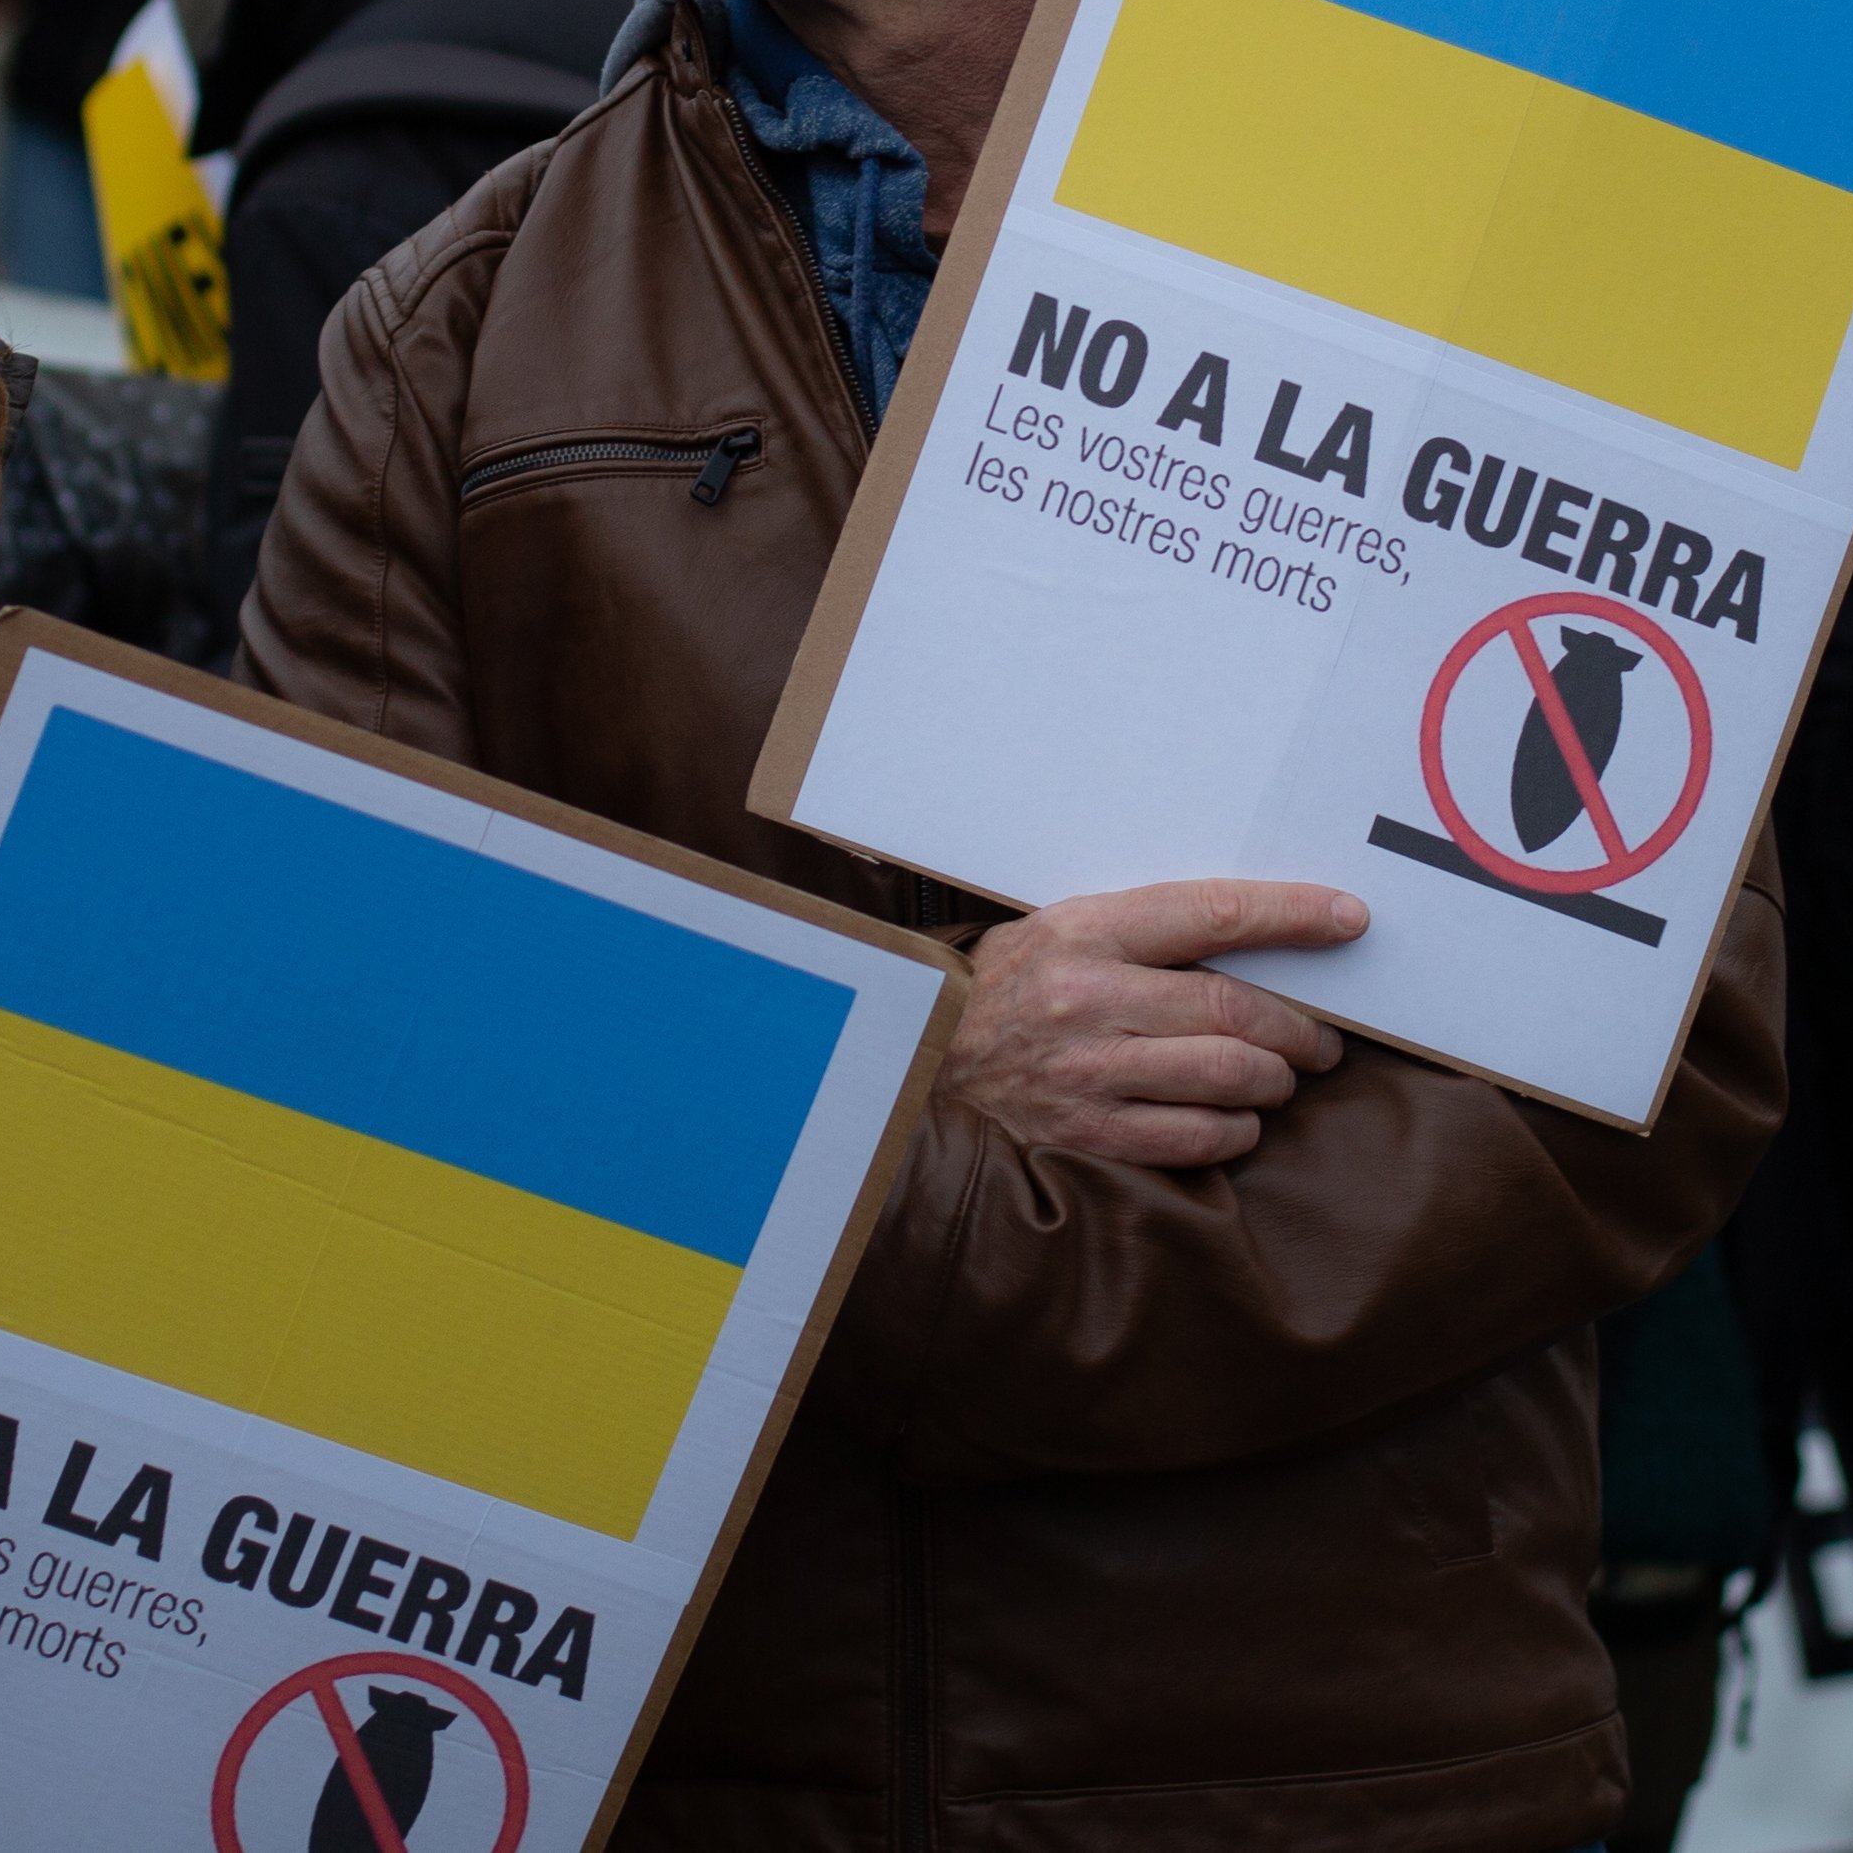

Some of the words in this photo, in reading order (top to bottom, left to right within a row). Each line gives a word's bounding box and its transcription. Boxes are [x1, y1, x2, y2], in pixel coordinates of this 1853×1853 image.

[965, 441, 1029, 502] les
[1040, 480, 1200, 564] nostres
[1211, 540, 1337, 613] morts
[985, 384, 1064, 451] Les
[1080, 426, 1231, 510] vostres
[1239, 488, 1412, 586] guerres,
[1008, 292, 1149, 409] NO
[1155, 352, 1229, 446] A
[1254, 380, 1374, 498] LA
[1403, 437, 1768, 644] GUERRA
[23, 1551, 209, 1647] guerres,
[42, 1440, 173, 1562] LA
[202, 1495, 596, 1701] GUERRA
